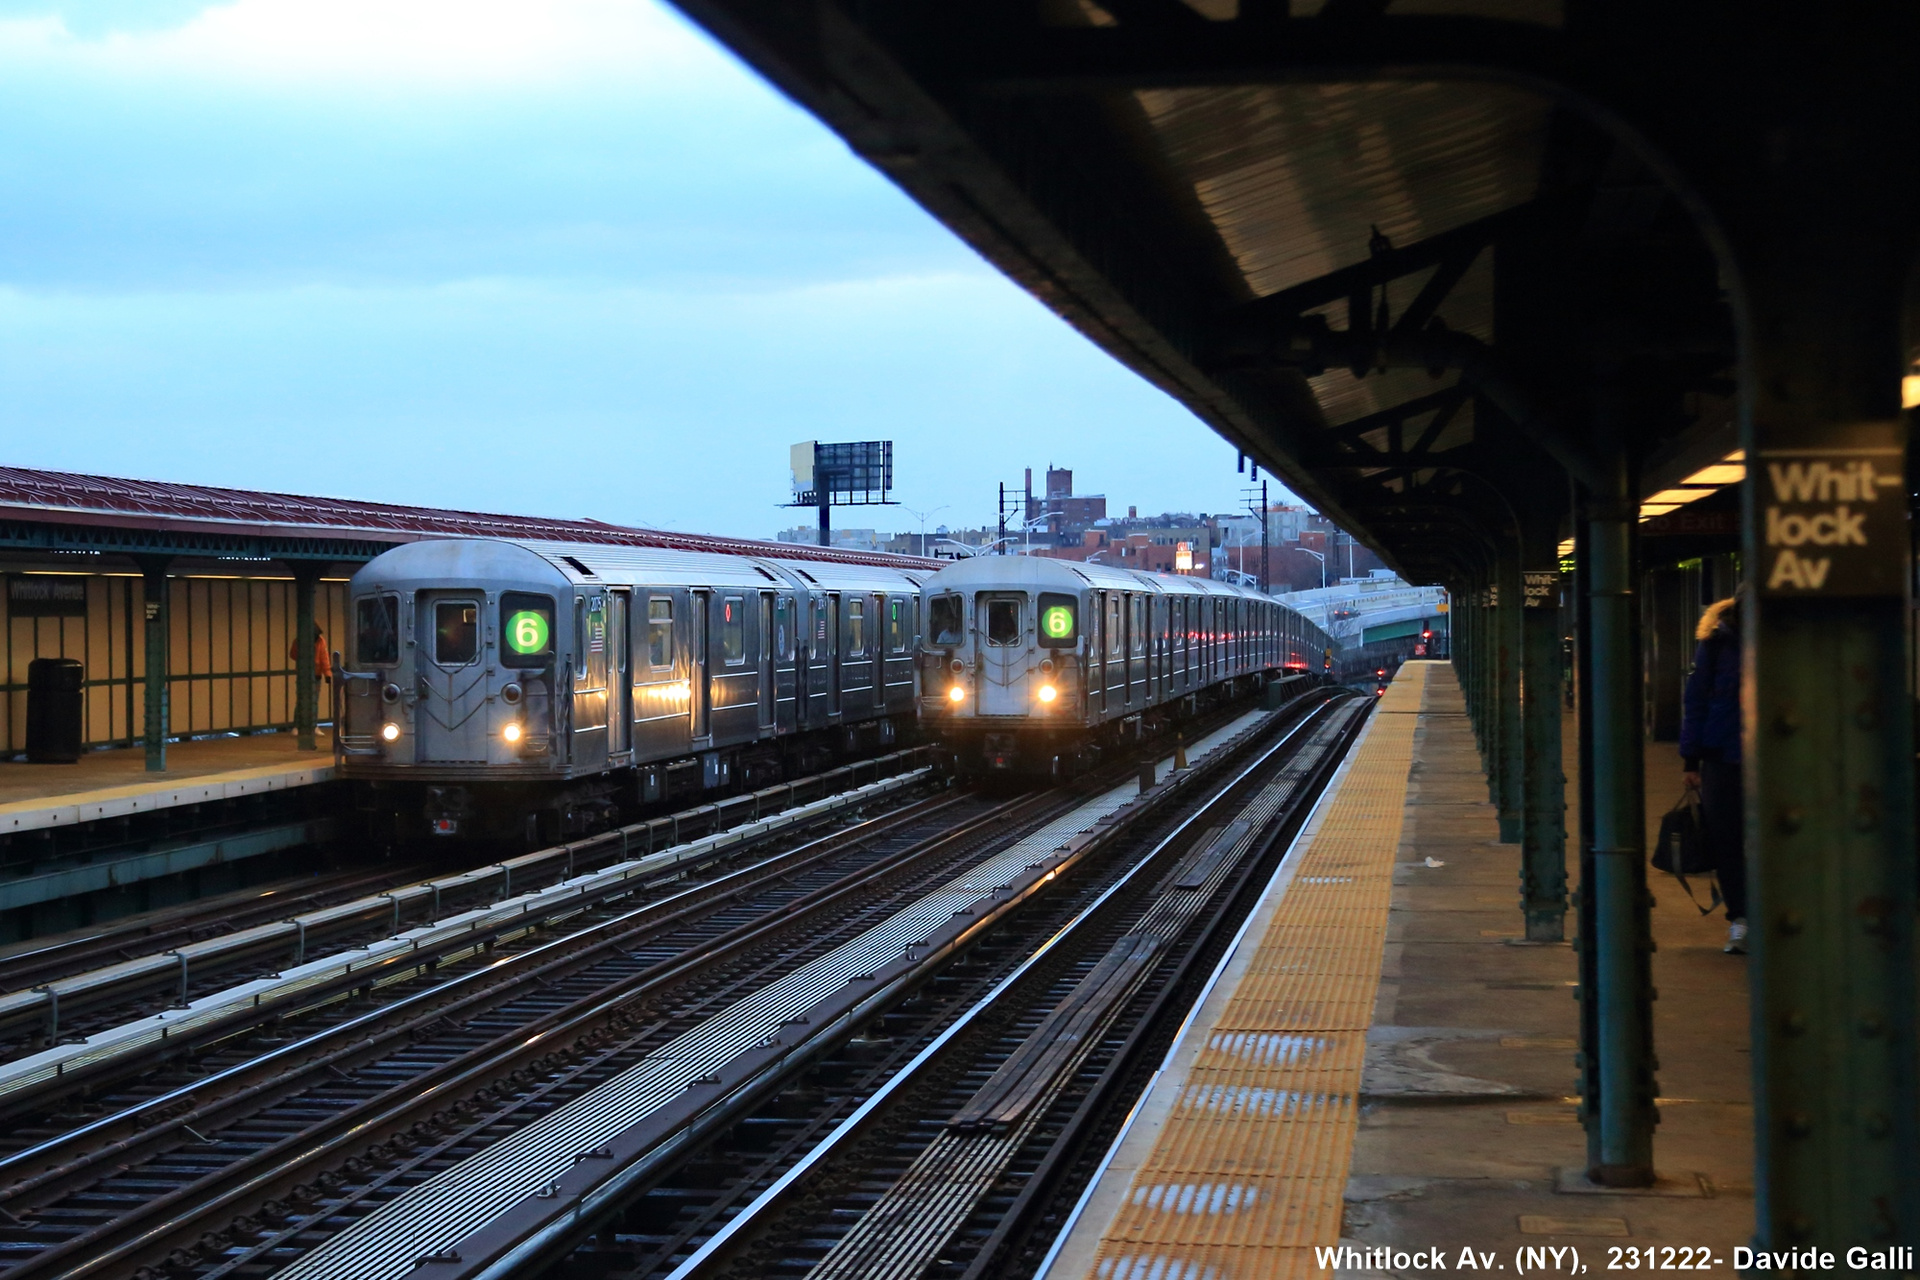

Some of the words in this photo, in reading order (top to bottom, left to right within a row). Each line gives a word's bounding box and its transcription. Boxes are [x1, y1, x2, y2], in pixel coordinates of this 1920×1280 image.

[1767, 461, 1902, 502] Whit-
[1766, 505, 1868, 545] lock
[1766, 549, 1831, 589] Av
[10, 580, 49, 600] Whitlock
[53, 582, 84, 600] Avenue
[1524, 585, 1550, 596] lock
[1524, 597, 1541, 607] Av
[516, 618, 539, 647] 6
[1049, 612, 1066, 633] 6
